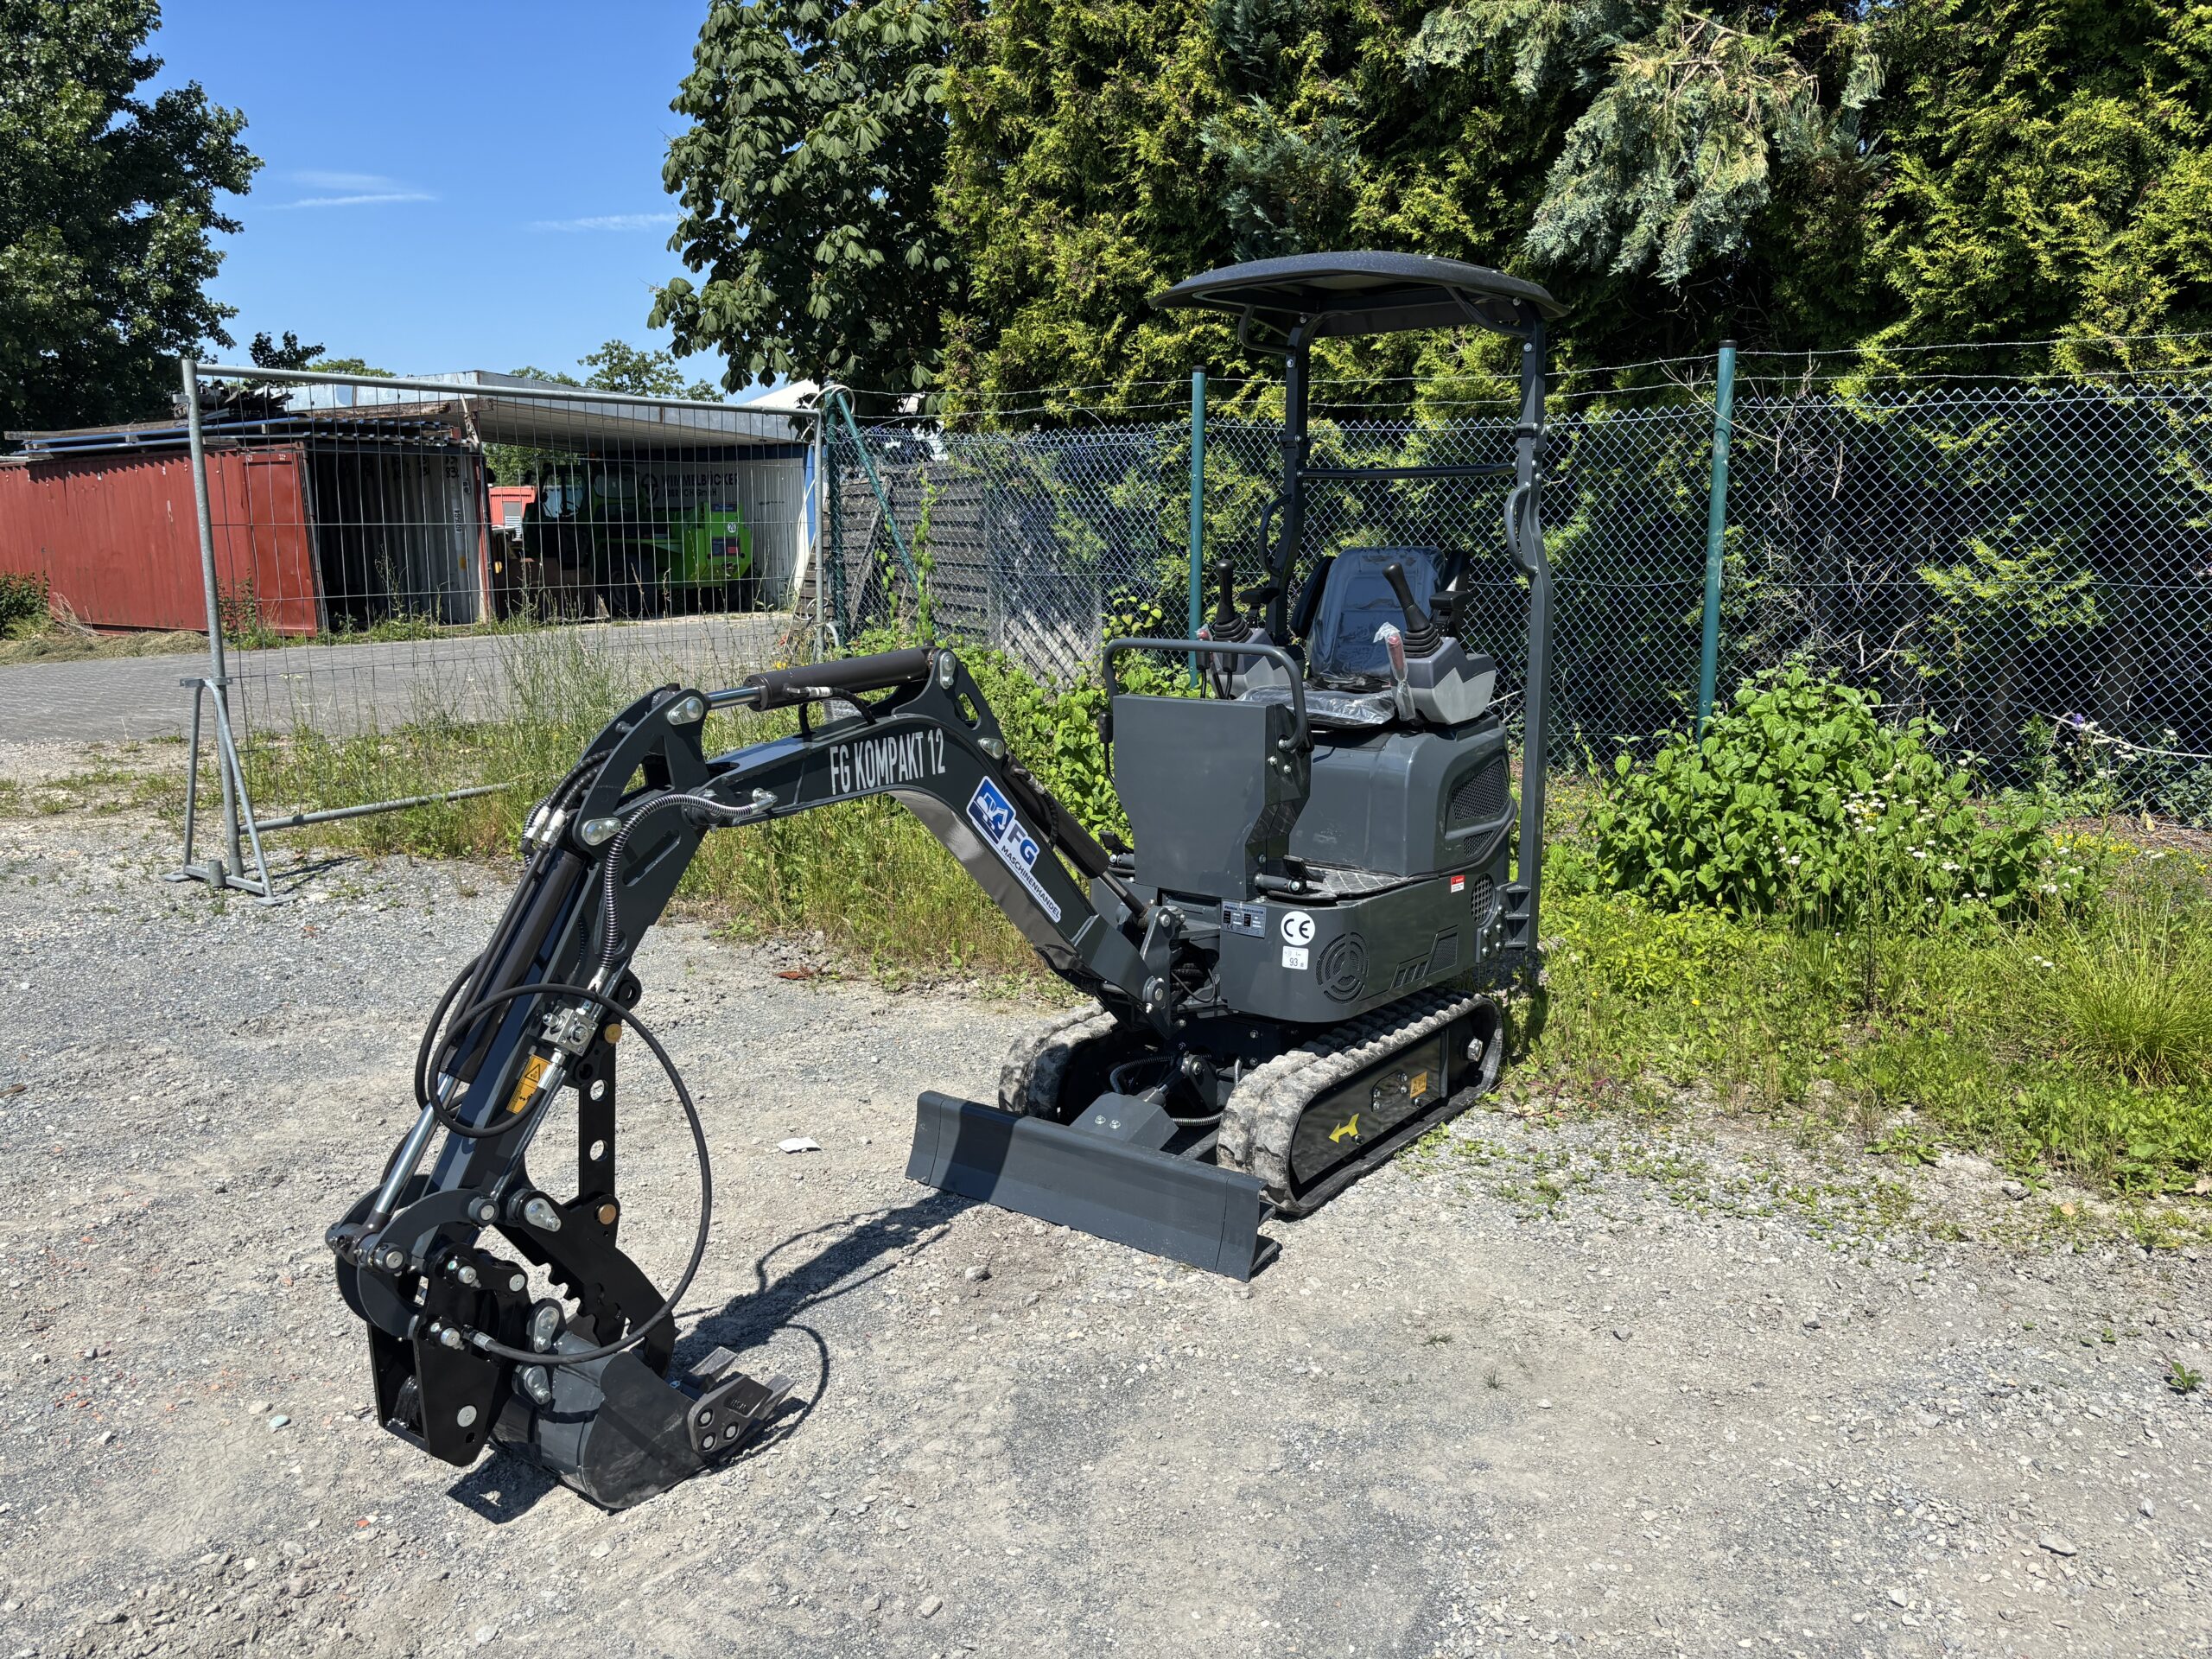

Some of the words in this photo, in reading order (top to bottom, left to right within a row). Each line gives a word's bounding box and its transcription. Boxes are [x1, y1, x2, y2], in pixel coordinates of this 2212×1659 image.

[830, 745, 851, 795] FG
[854, 731, 924, 791] KOMPAKT
[927, 728, 946, 775] 12
[1007, 823, 1038, 865] FG
[1001, 845, 1061, 918] MASCHINENHANDEL
[1283, 918, 1311, 939] CE
[1289, 957, 1299, 967] 93
